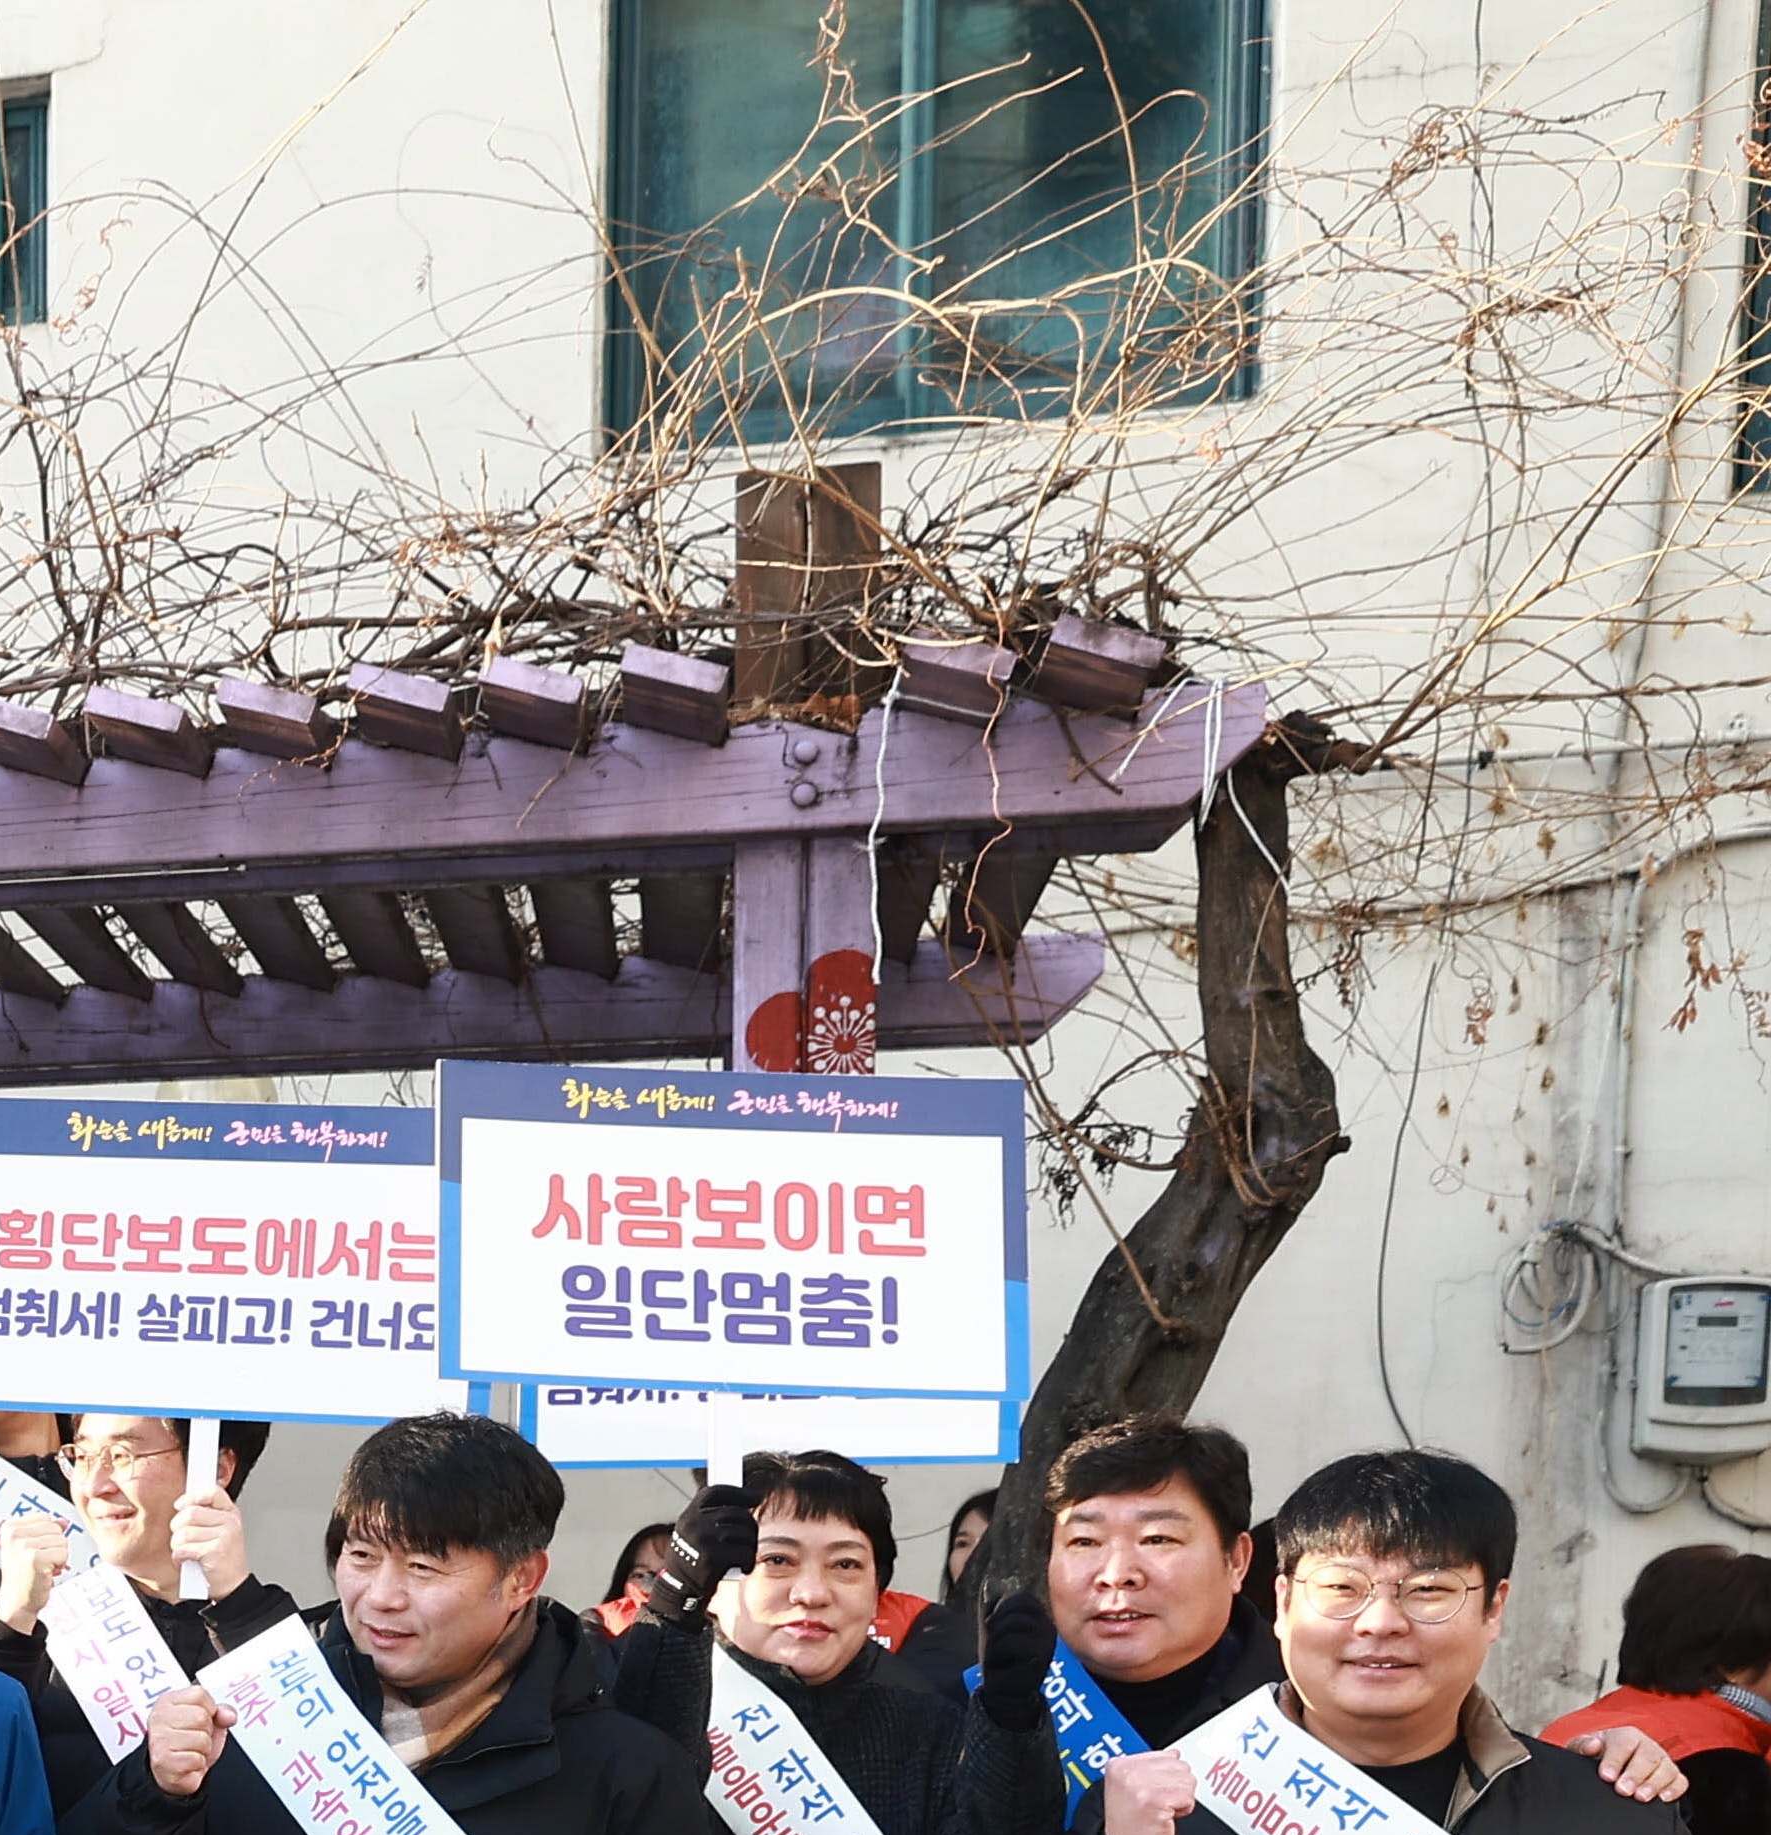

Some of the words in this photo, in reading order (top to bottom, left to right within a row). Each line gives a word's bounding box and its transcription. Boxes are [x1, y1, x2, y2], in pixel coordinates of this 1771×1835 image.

[531, 1172, 927, 1257] 사람보이면
[137, 1292, 292, 1346] 살피고!
[561, 1265, 900, 1348] 일단멈춤!
[225, 1672, 276, 1729] 음주
[268, 1649, 335, 1729] 모두의
[732, 1704, 780, 1743] 전
[769, 1748, 845, 1822] 좌석
[1241, 1715, 1281, 1761] 전
[1284, 1757, 1389, 1833] 좌석
